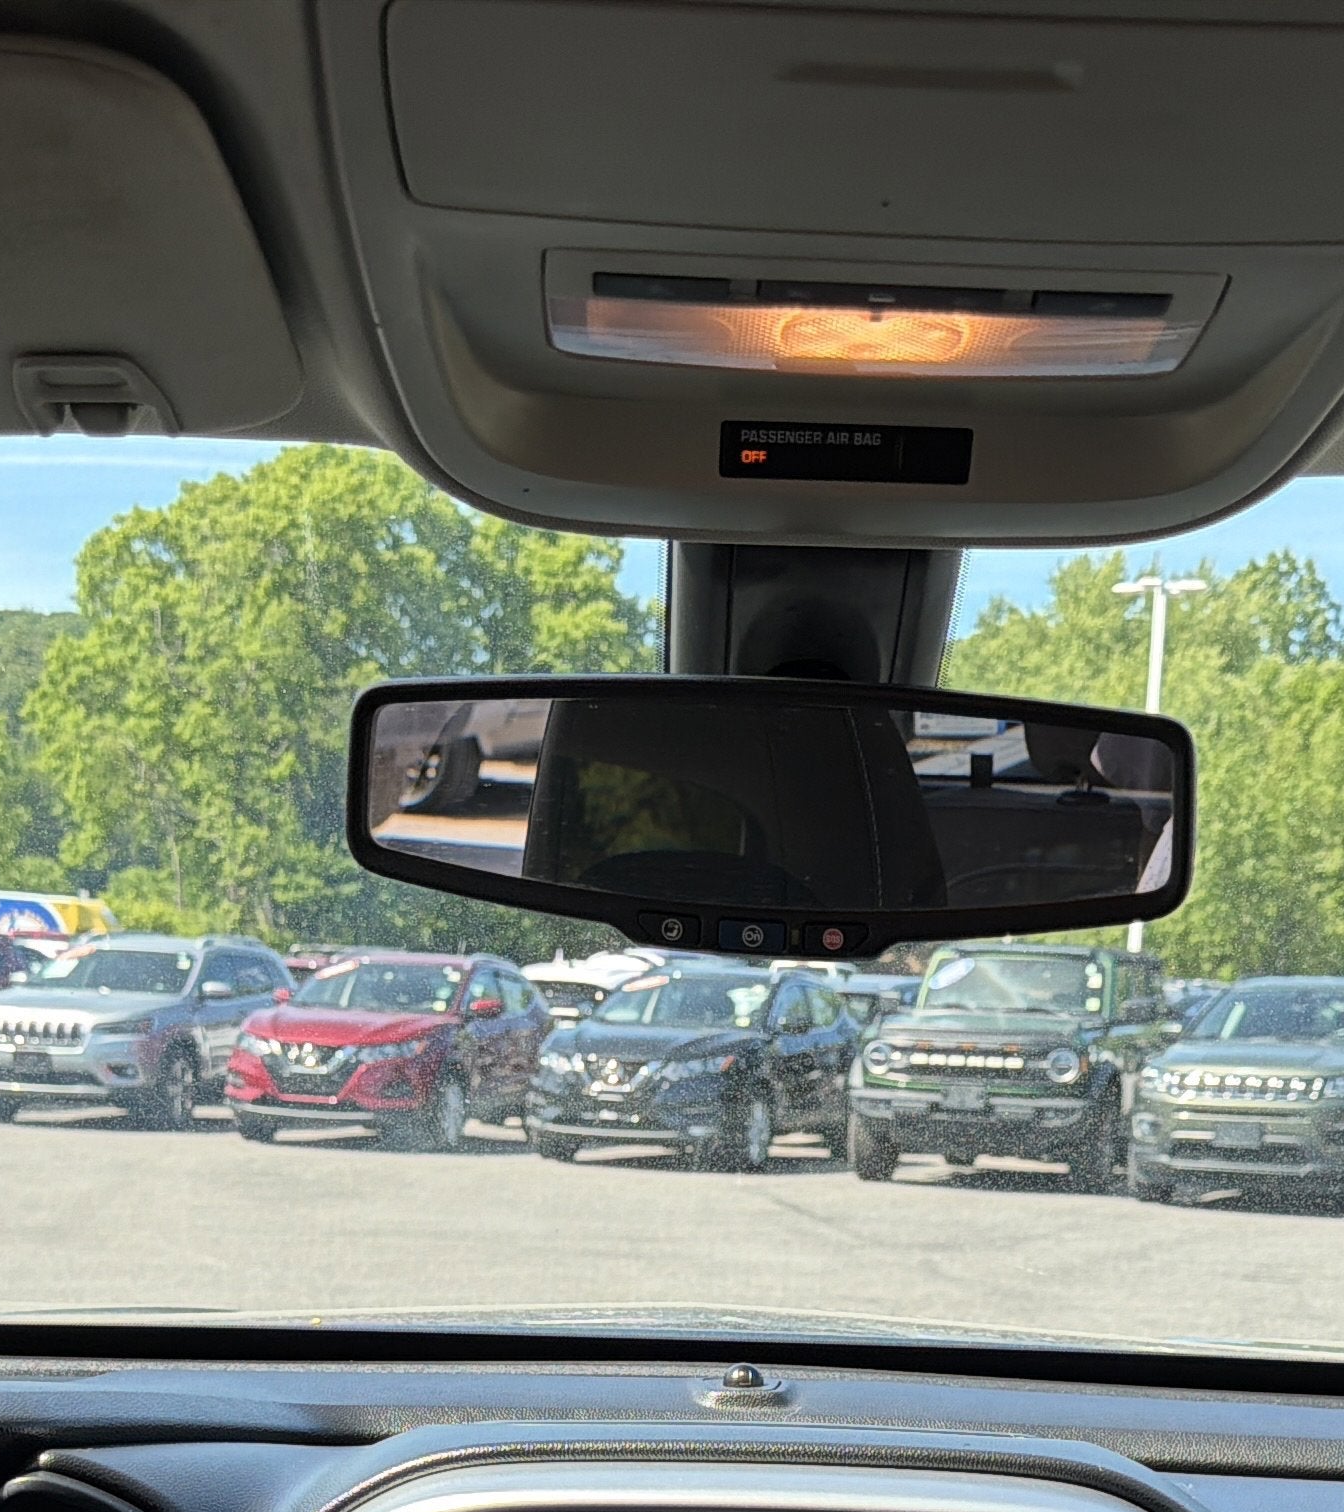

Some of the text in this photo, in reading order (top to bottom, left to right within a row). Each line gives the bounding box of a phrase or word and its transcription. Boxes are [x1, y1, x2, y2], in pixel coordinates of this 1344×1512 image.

[740, 430, 882, 447] PASSENGER AIR BAG
[741, 449, 768, 463] OFF
